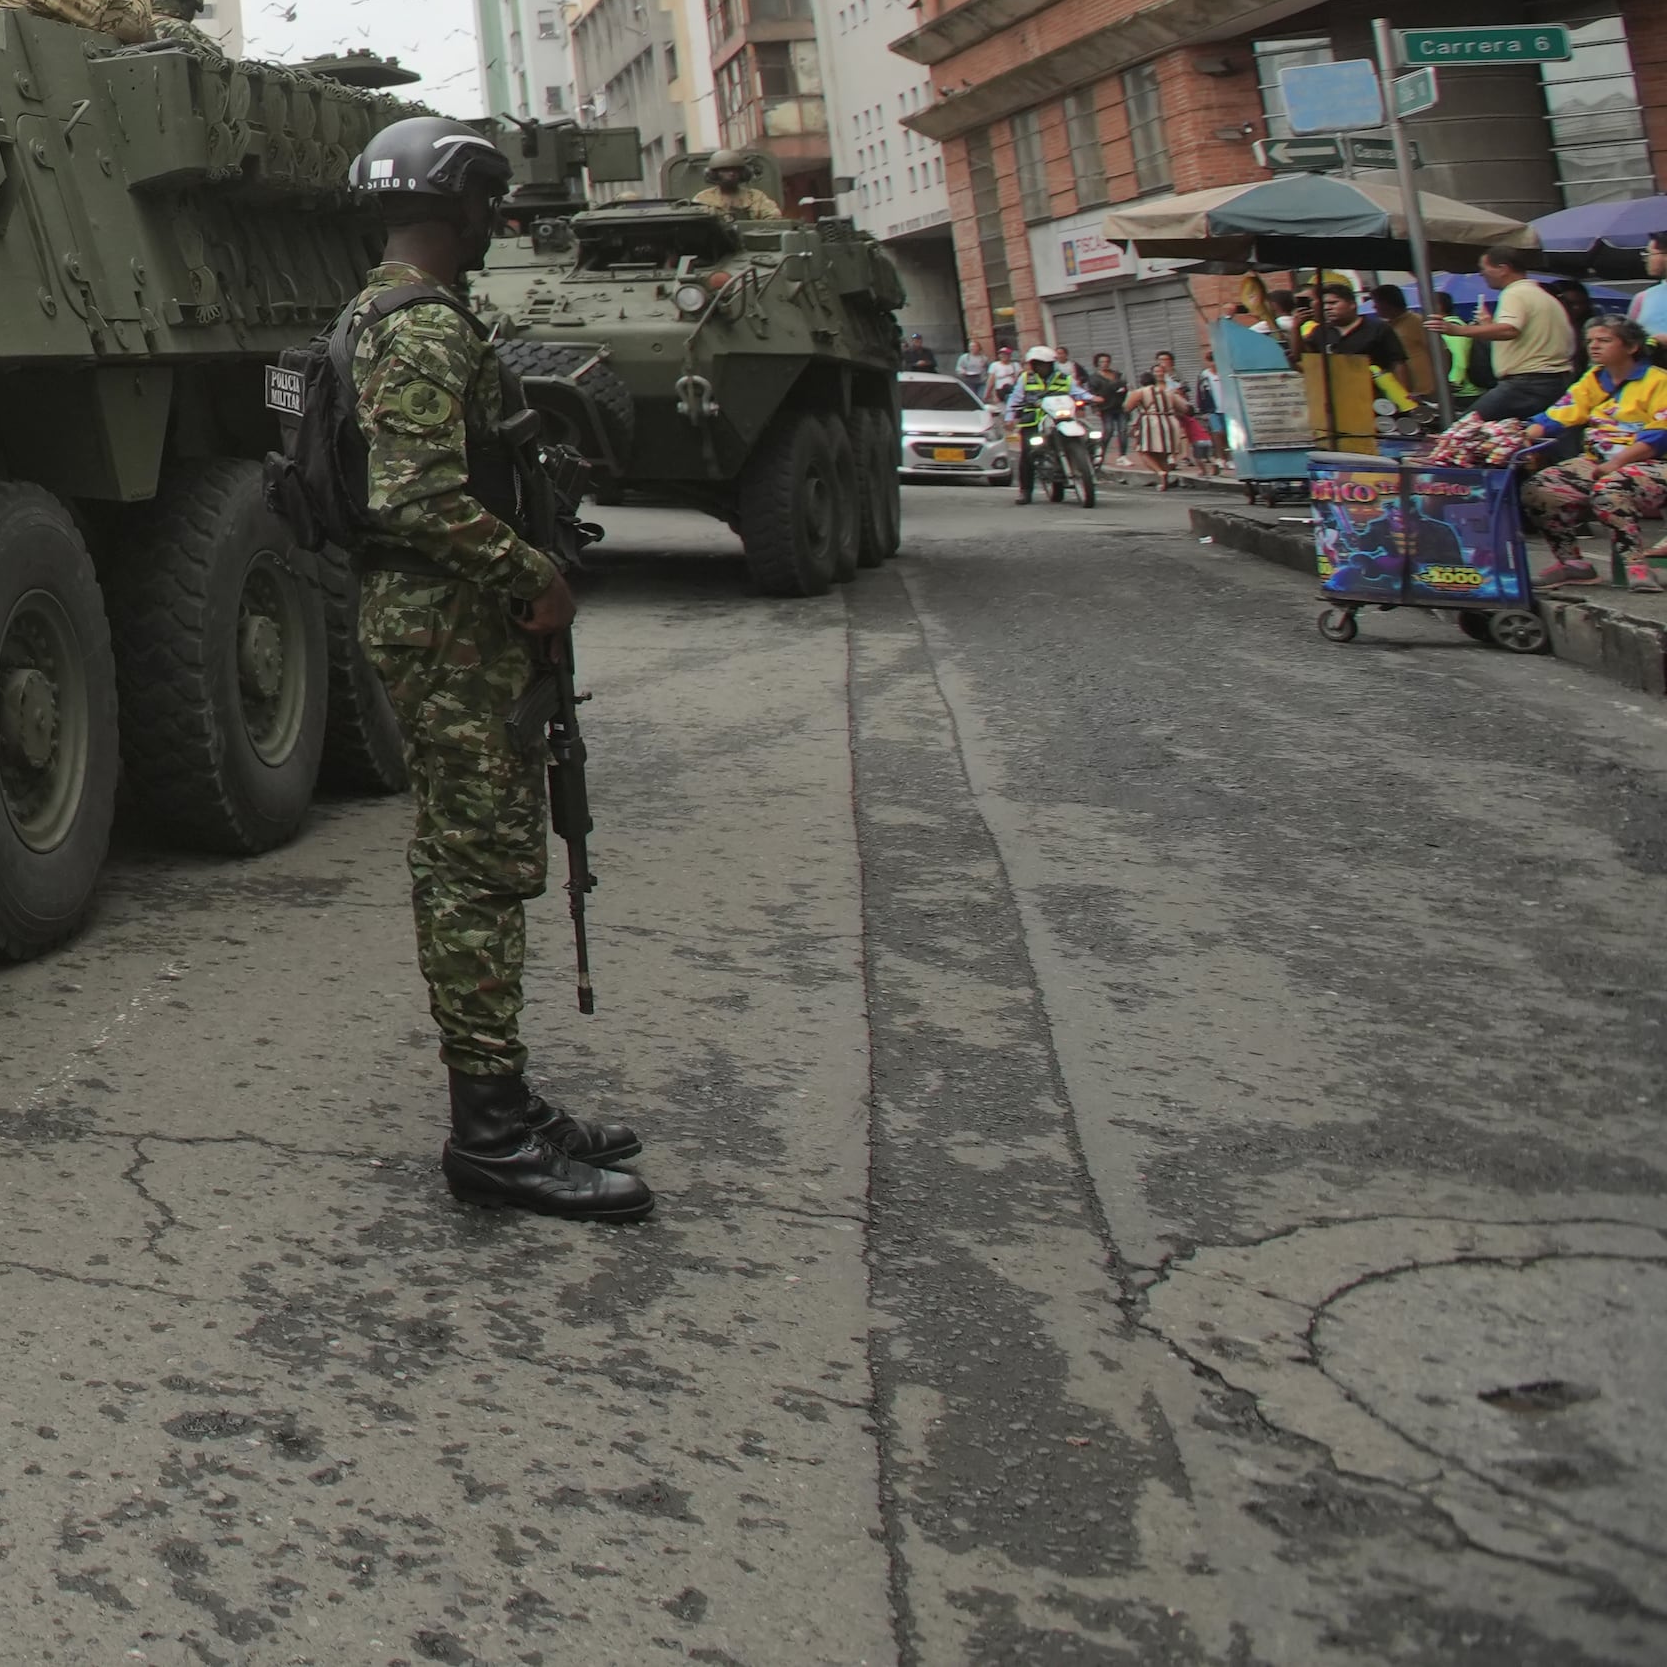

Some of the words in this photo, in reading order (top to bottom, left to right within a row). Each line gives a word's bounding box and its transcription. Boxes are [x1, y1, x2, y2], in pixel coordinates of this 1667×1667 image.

[1419, 39, 1523, 56] Carrera
[1532, 35, 1551, 52] 6
[270, 370, 301, 394] POLICIA
[270, 388, 301, 412] MILITAR
